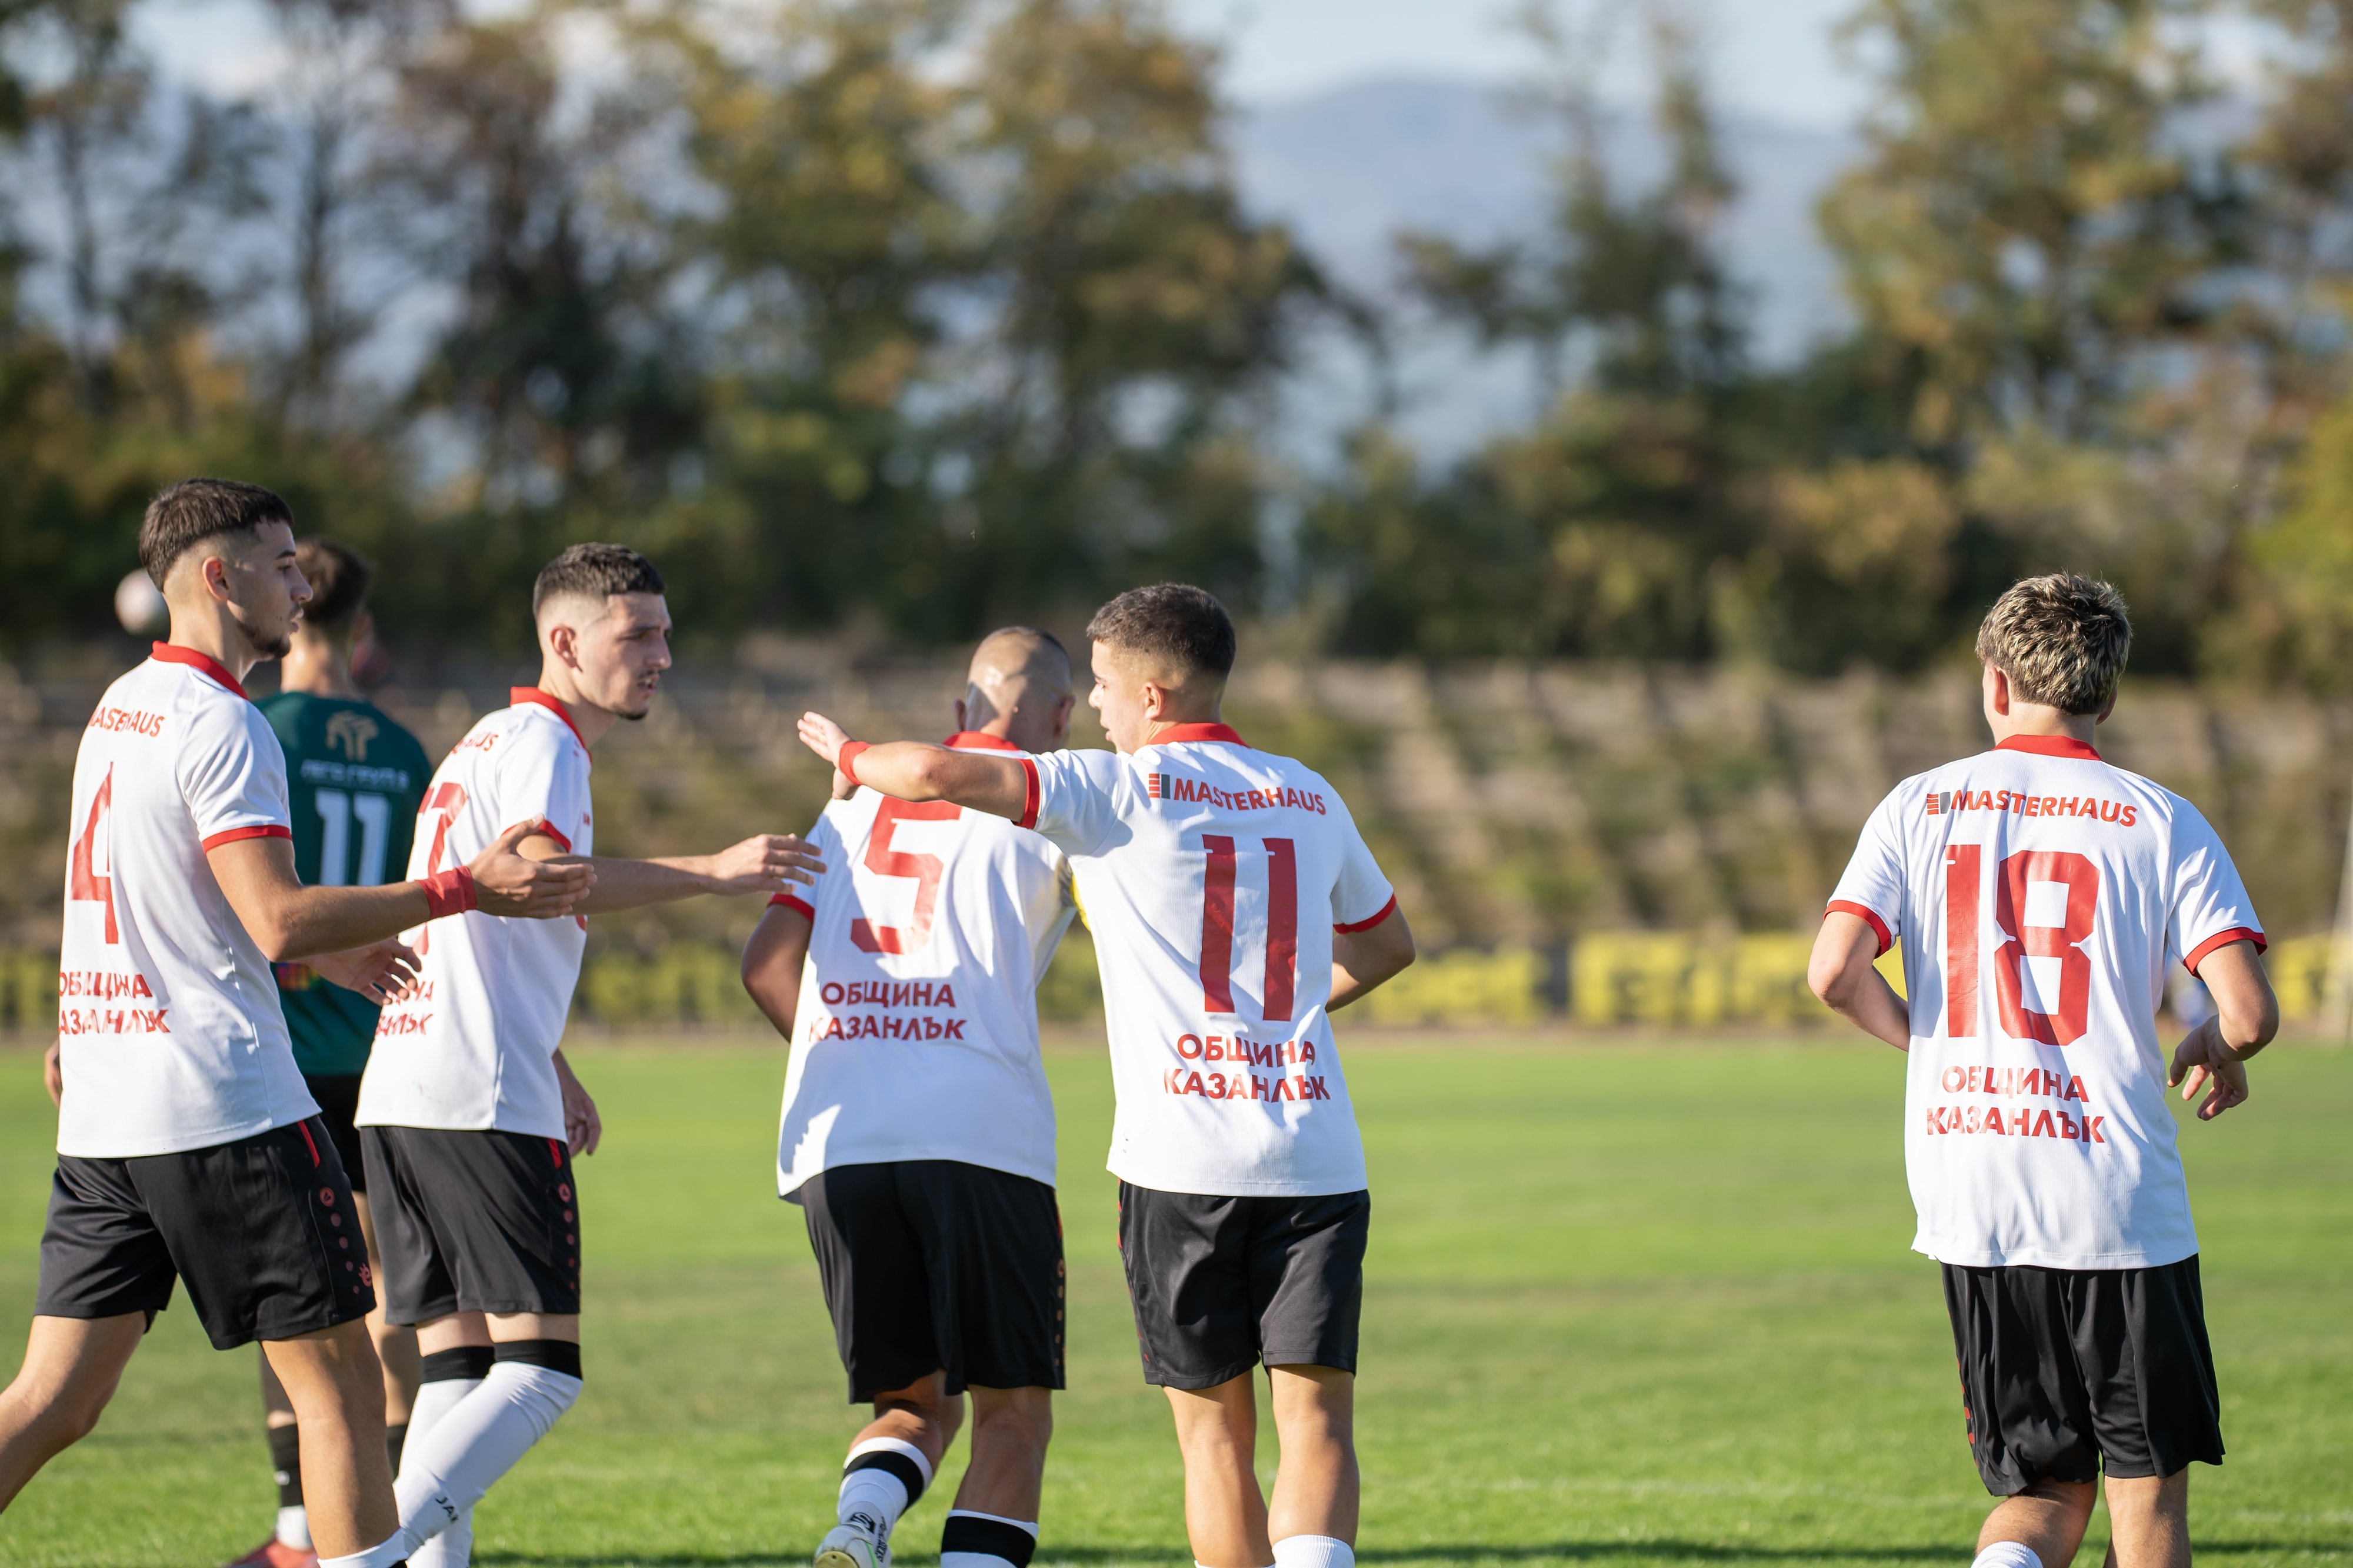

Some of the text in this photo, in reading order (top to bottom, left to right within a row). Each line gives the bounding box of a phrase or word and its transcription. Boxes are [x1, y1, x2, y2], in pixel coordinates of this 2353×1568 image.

[1174, 778, 1326, 815] MASTERHAUS
[1951, 789, 2137, 827] MASTERHAUS
[70, 761, 118, 945] 4
[315, 788, 392, 886] 11
[851, 796, 963, 955] 5
[1199, 834, 1298, 1022] 11
[1944, 844, 2100, 1046] 18
[821, 981, 956, 1009] ОБЩИНА
[809, 1015, 967, 1042] КАЗАНЛЪК
[1177, 1033, 1315, 1067] ОБЩИНА
[1164, 1068, 1331, 1103] КАЗАНЛЪК
[1942, 1066, 2089, 1103] ОБЩИНА
[1927, 1106, 2105, 1143] КАЗАНЛЪК
